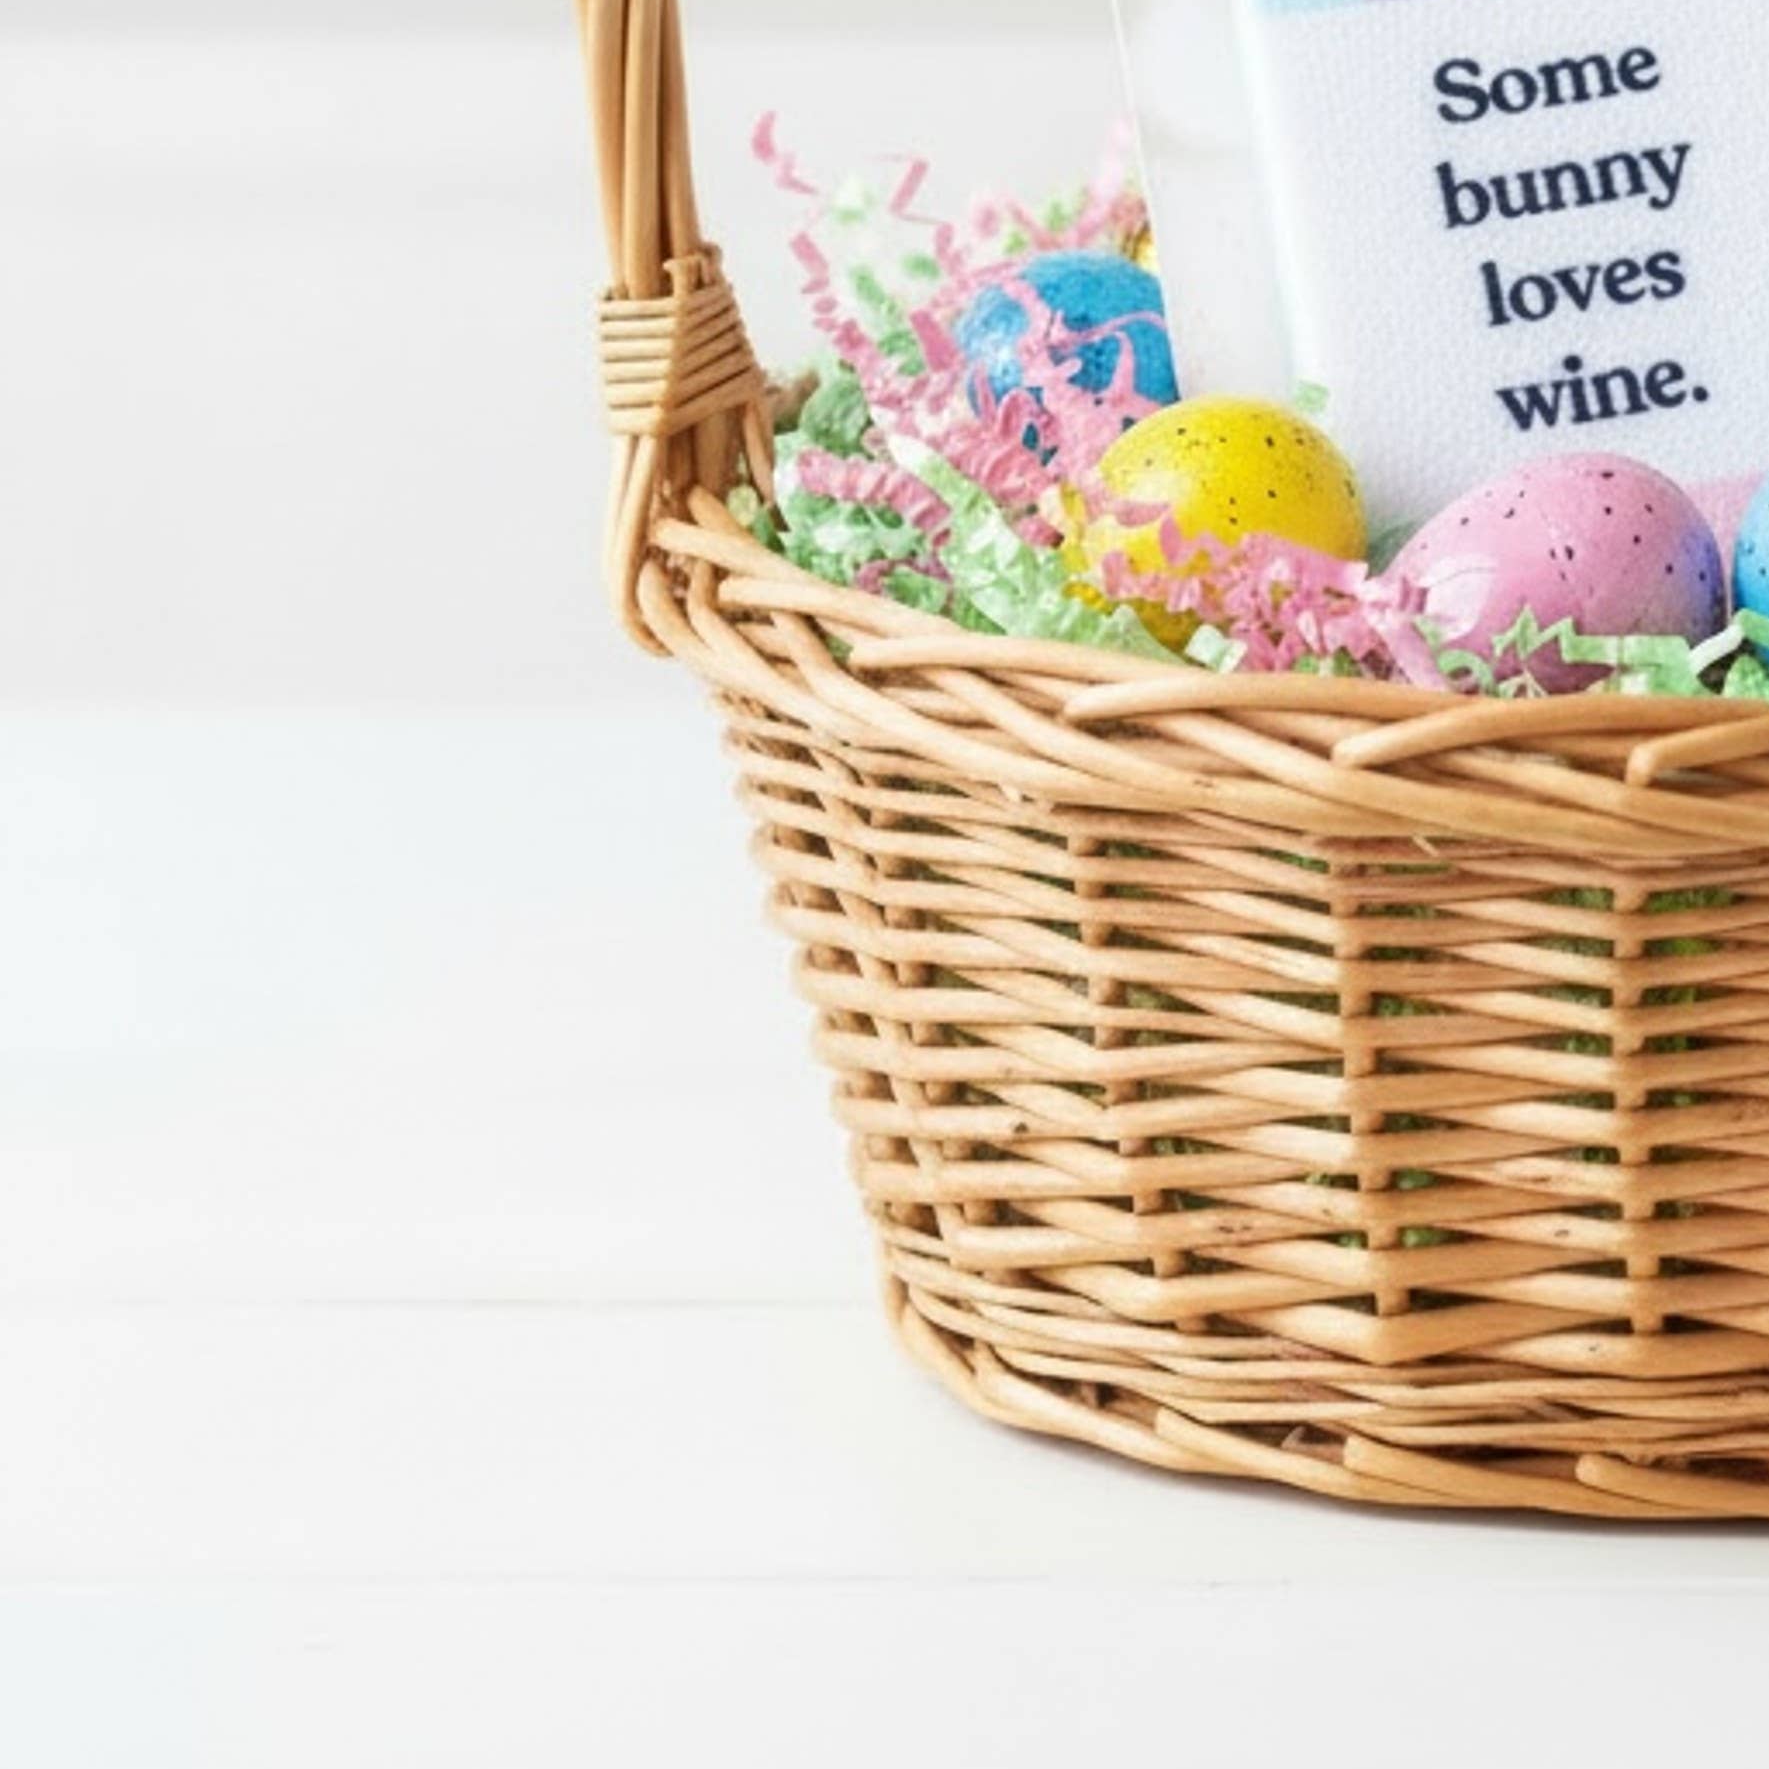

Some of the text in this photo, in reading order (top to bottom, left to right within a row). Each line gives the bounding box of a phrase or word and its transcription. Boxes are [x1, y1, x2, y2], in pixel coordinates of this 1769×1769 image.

[1434, 46, 1661, 123] Some
[1435, 143, 1691, 229] bunny
[1480, 249, 1687, 326] loves
[1495, 353, 1710, 432] wine.
